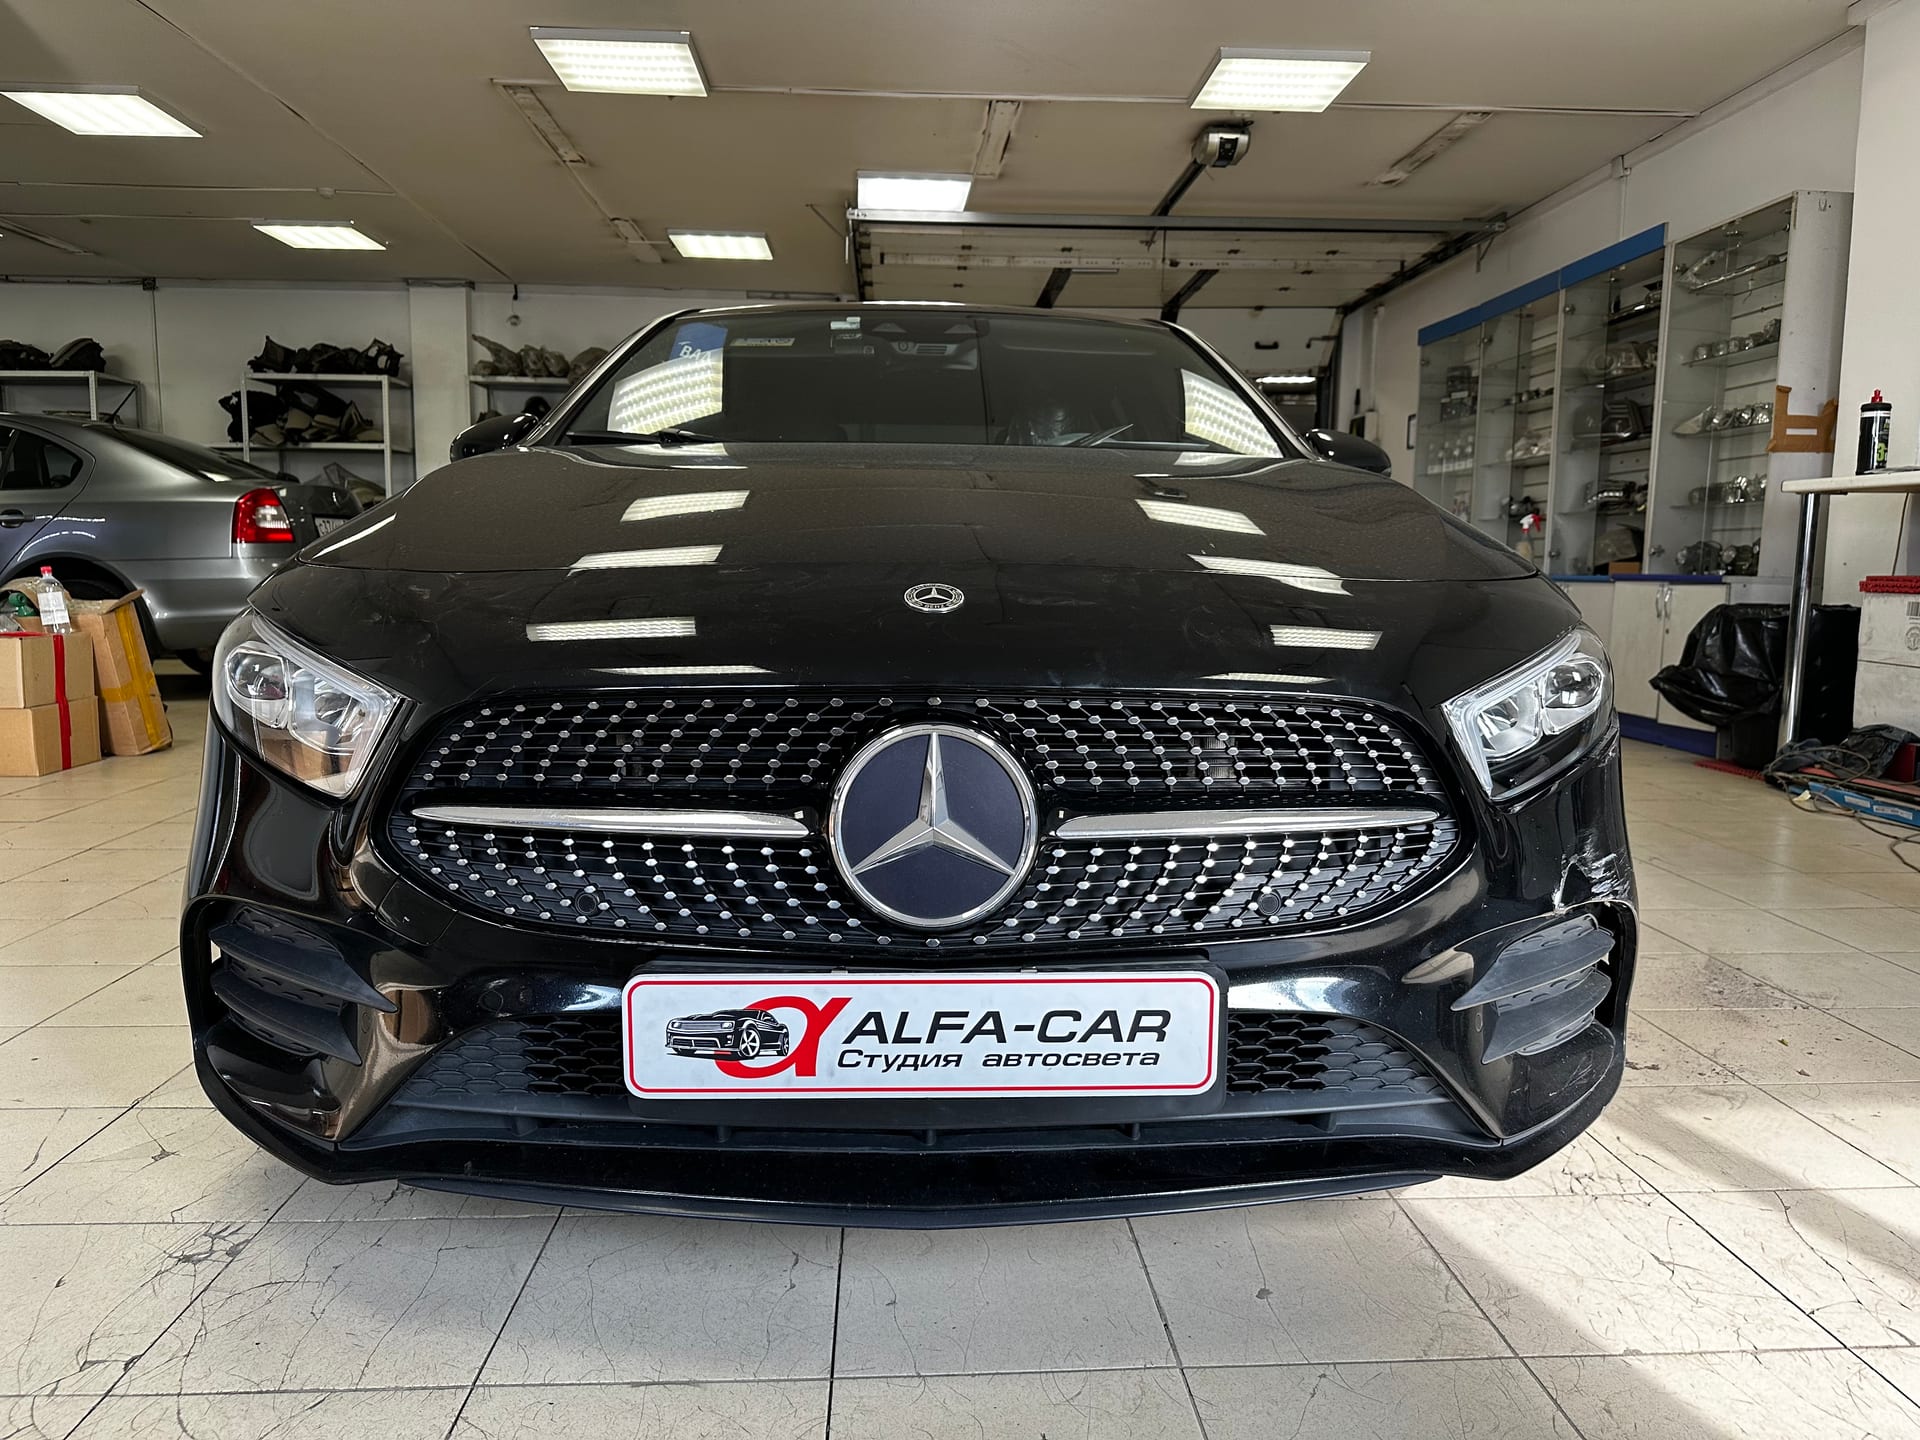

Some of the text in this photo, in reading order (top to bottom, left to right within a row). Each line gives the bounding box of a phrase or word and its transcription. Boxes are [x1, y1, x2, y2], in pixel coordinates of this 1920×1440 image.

[842, 1009, 1171, 1044] ALFA-CAR
[837, 1048, 1161, 1073] Студия автосвета
